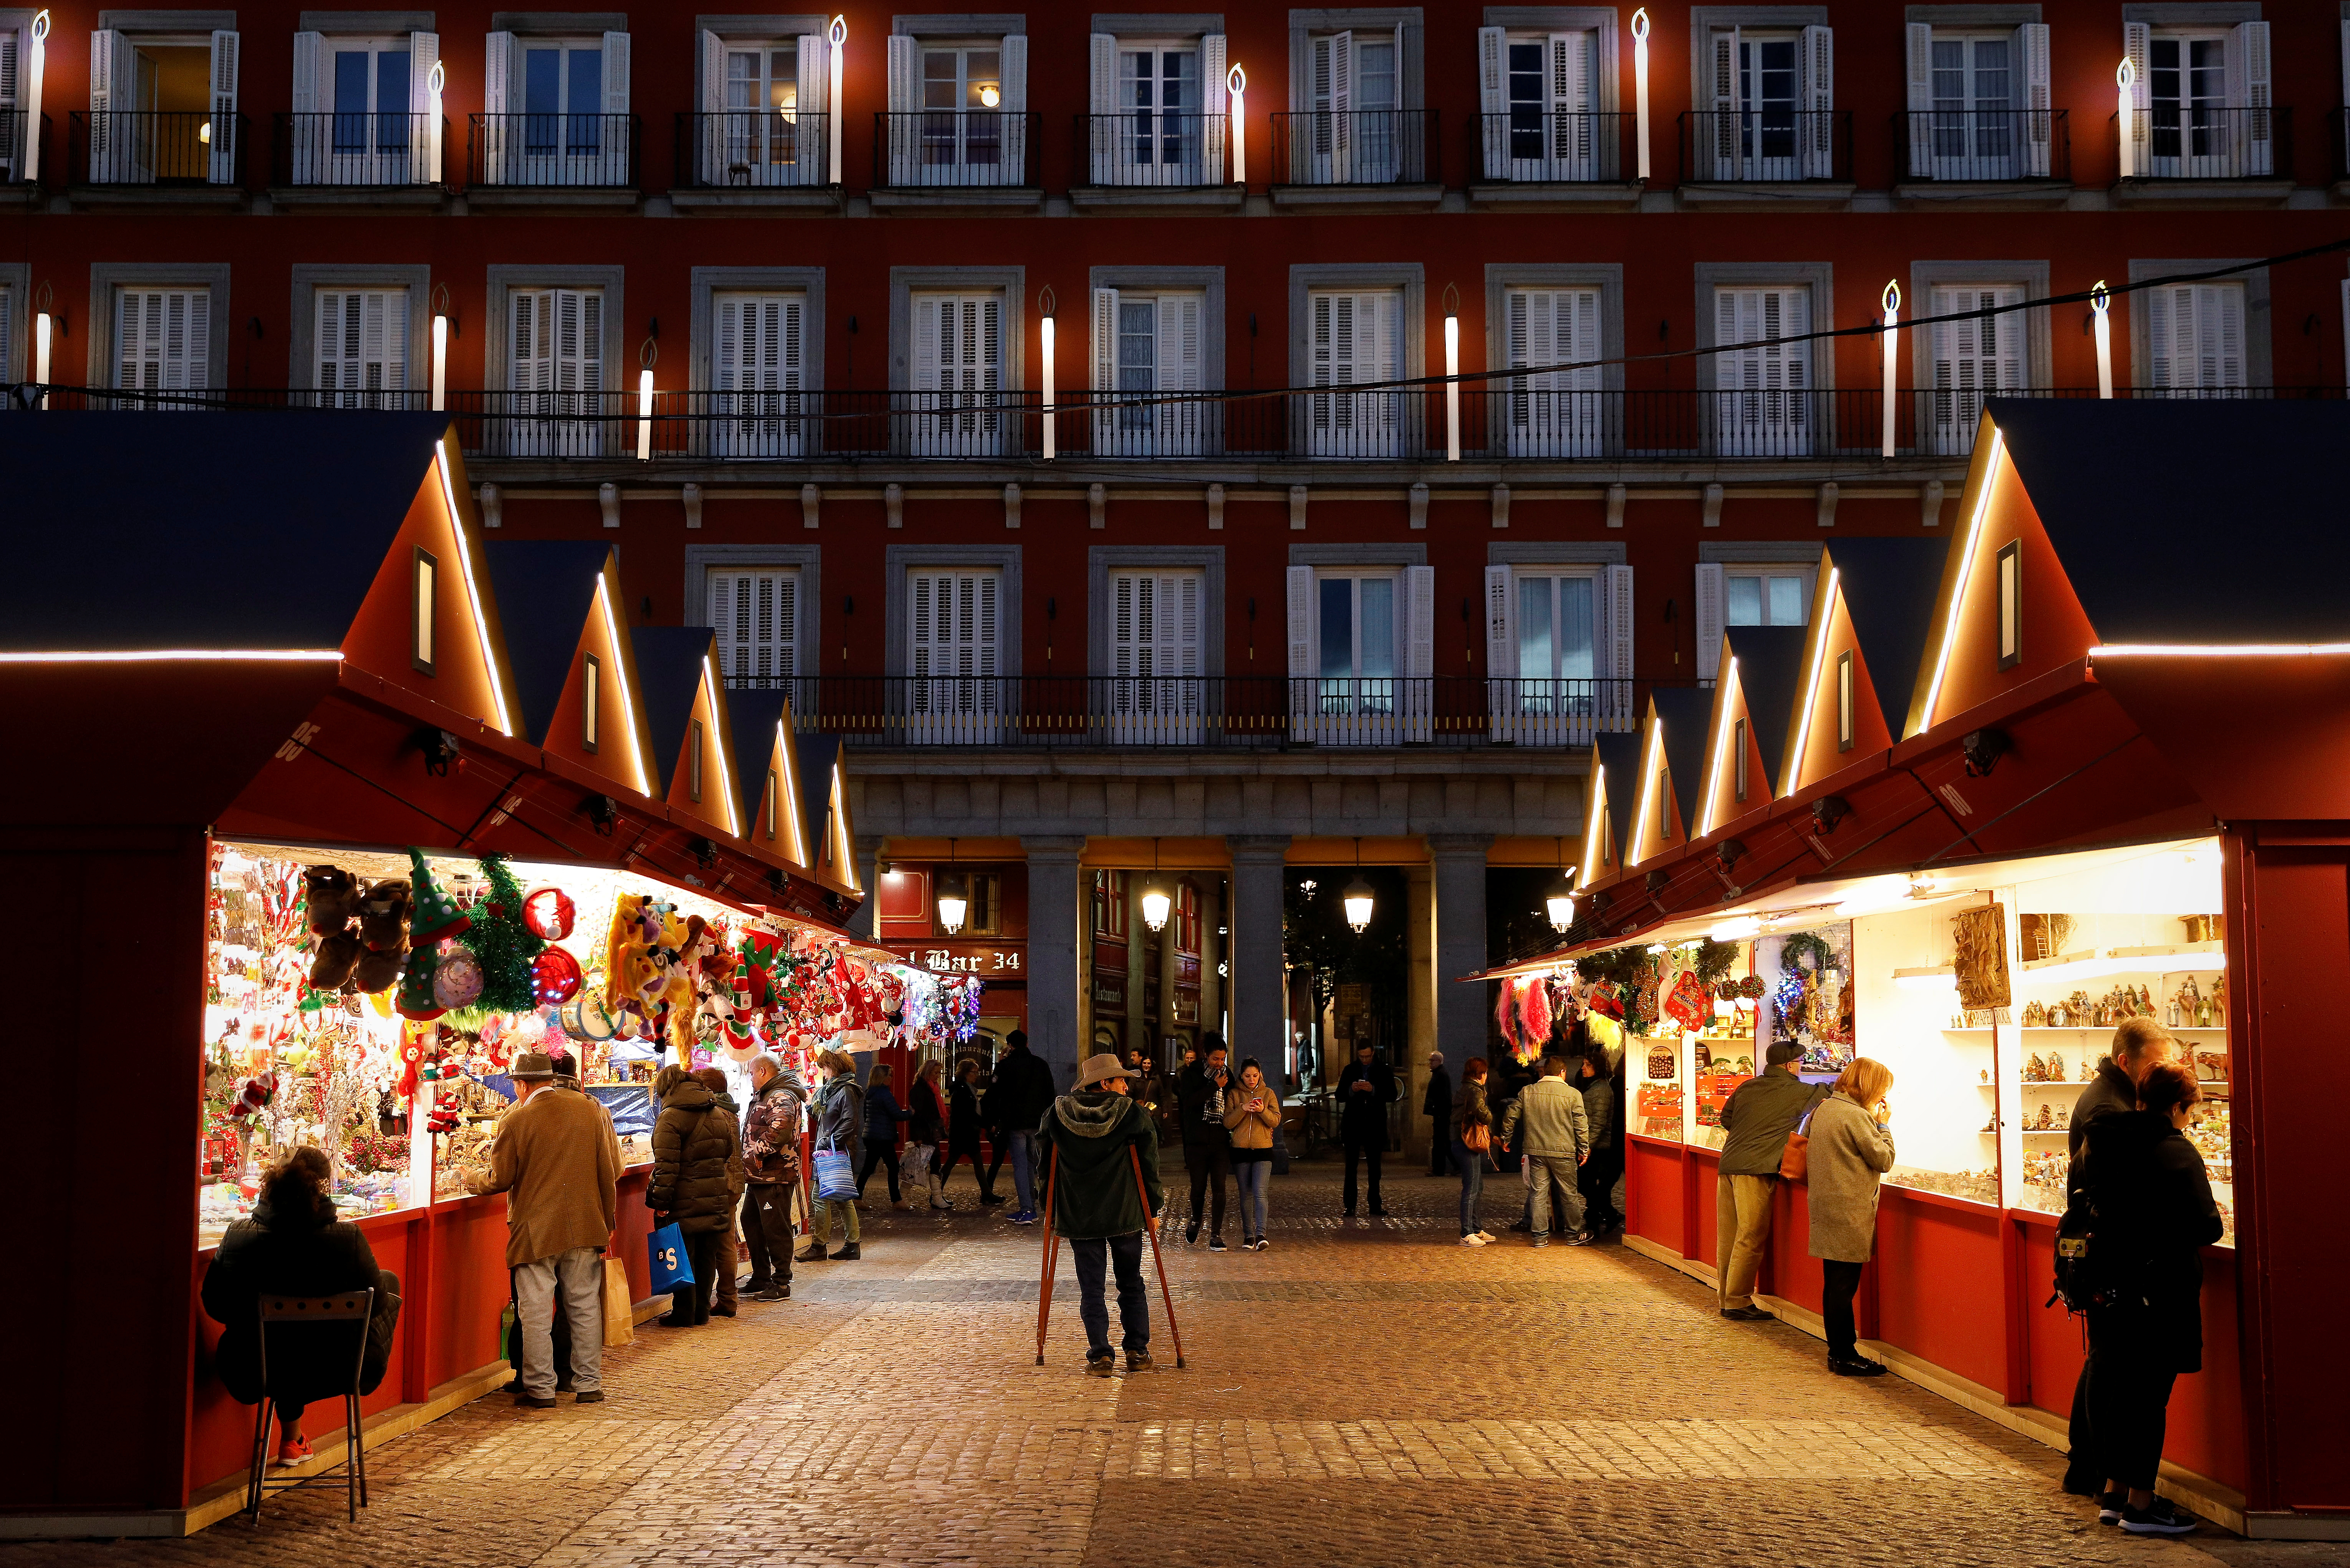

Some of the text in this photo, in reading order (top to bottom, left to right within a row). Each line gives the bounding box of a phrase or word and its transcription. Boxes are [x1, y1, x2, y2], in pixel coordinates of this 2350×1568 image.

[925, 949, 983, 972] Bar
[992, 952, 1020, 970] 34
[1975, 1009, 2011, 1025] PAPEL ROCA
